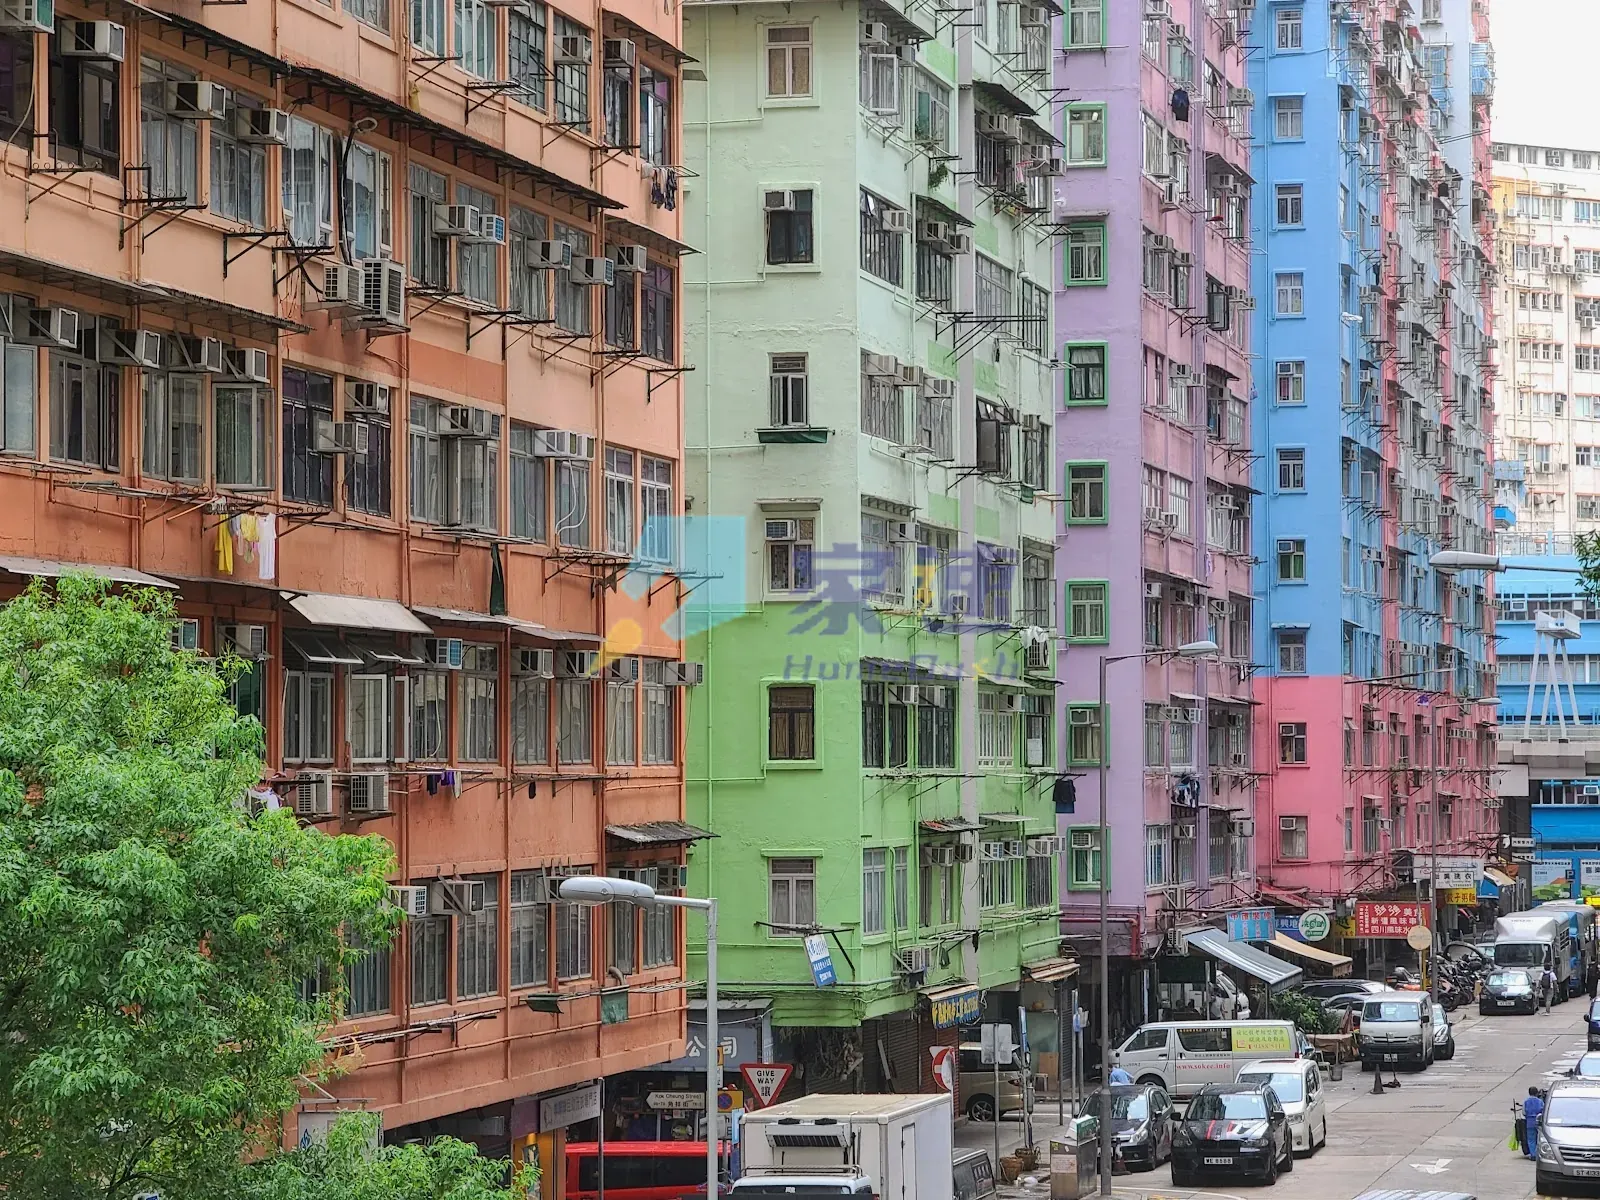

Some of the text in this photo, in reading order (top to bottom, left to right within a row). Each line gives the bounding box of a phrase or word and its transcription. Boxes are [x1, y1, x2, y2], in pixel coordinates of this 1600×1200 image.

[1371, 916, 1422, 925] 新疆風味串
